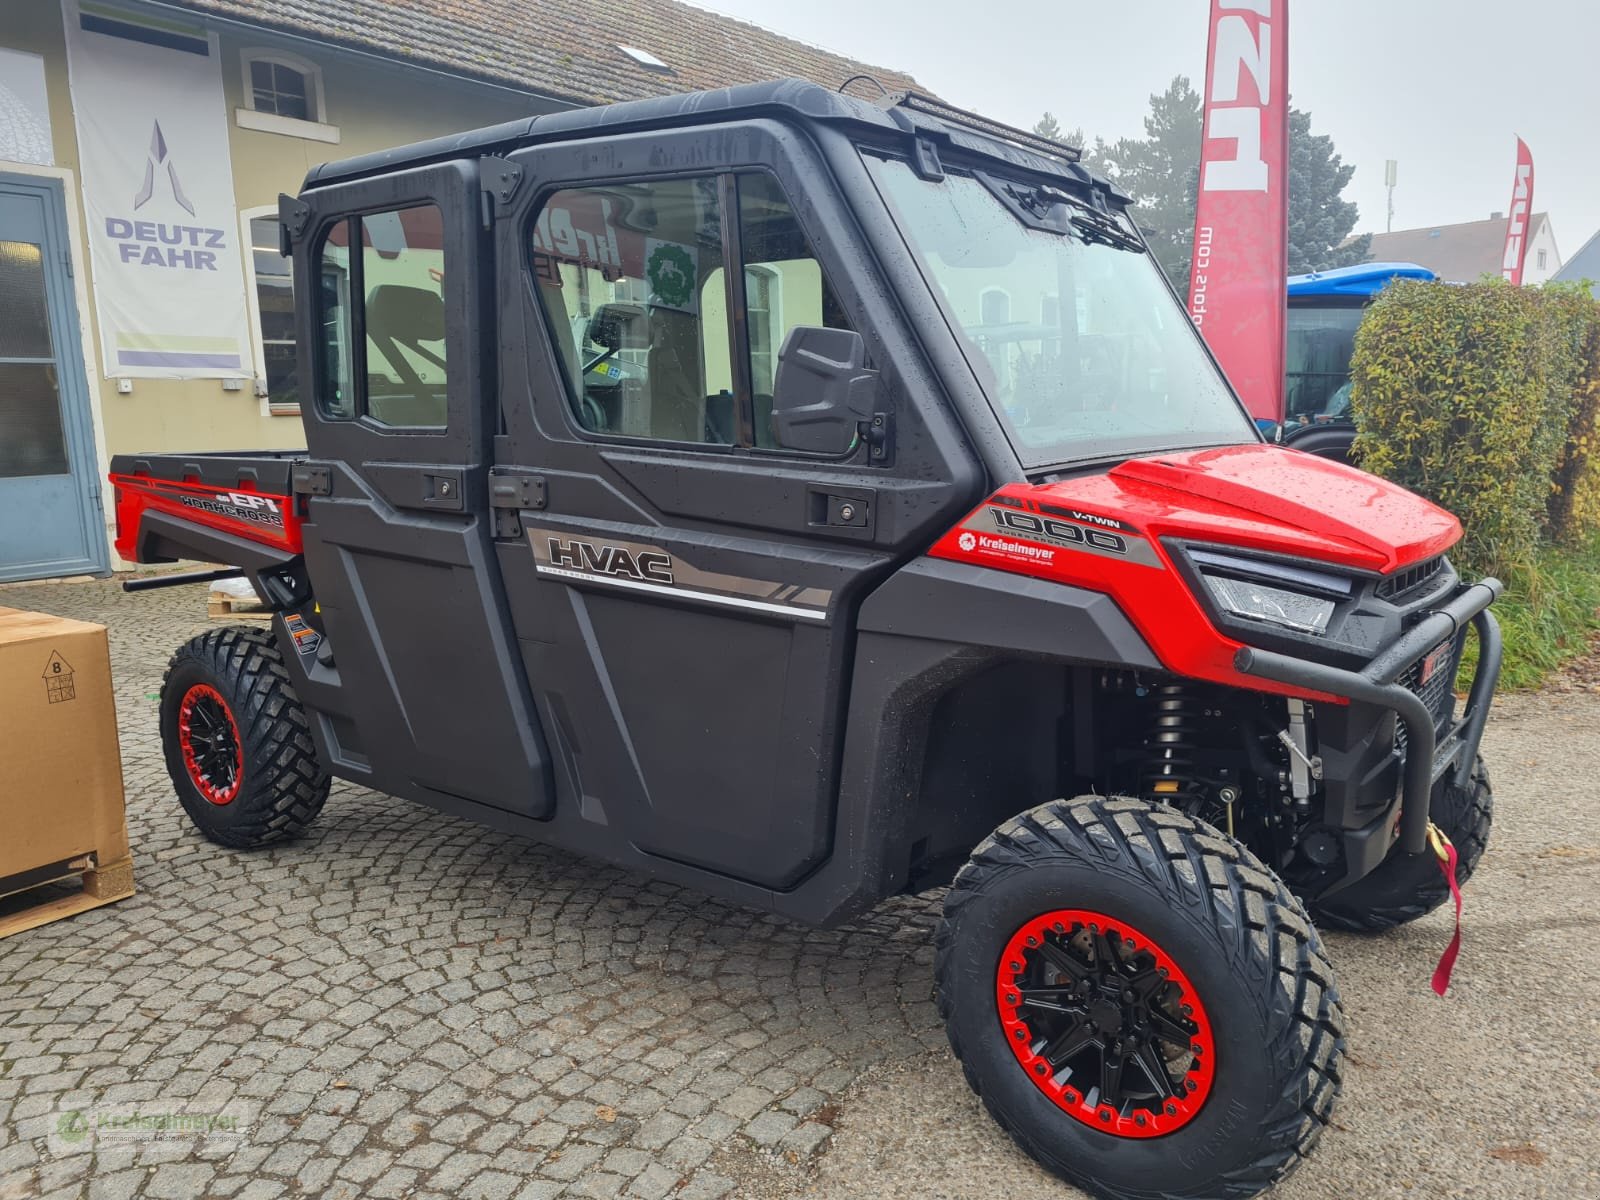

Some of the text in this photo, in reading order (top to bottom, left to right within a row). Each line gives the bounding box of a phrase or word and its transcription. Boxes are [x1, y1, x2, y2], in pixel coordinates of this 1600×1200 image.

[105, 217, 226, 249] DEUTZ
[118, 243, 218, 271] FAHR
[228, 492, 280, 513] EFI
[988, 507, 1129, 554] 1000
[1072, 510, 1121, 529] V-TWIN
[547, 536, 675, 585] HVAC
[979, 535, 1055, 560] Kreiselmeyer
[52, 661, 62, 674] 8
